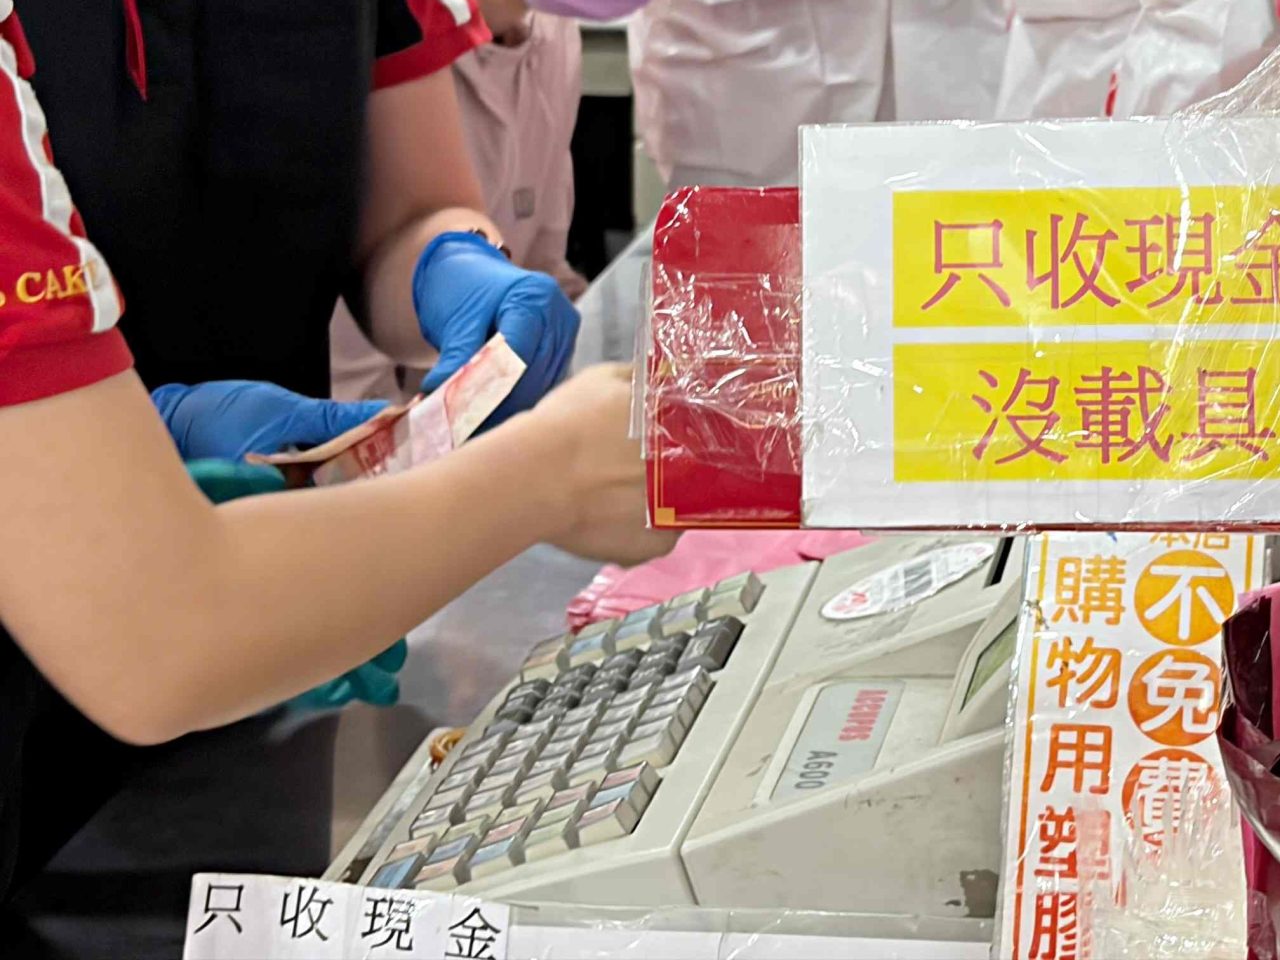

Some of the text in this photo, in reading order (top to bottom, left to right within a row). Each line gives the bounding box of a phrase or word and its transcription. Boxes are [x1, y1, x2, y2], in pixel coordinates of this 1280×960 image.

[970, 367, 1277, 464] 沒載具
[794, 750, 839, 790] A600
[194, 883, 502, 960] 只收現金
